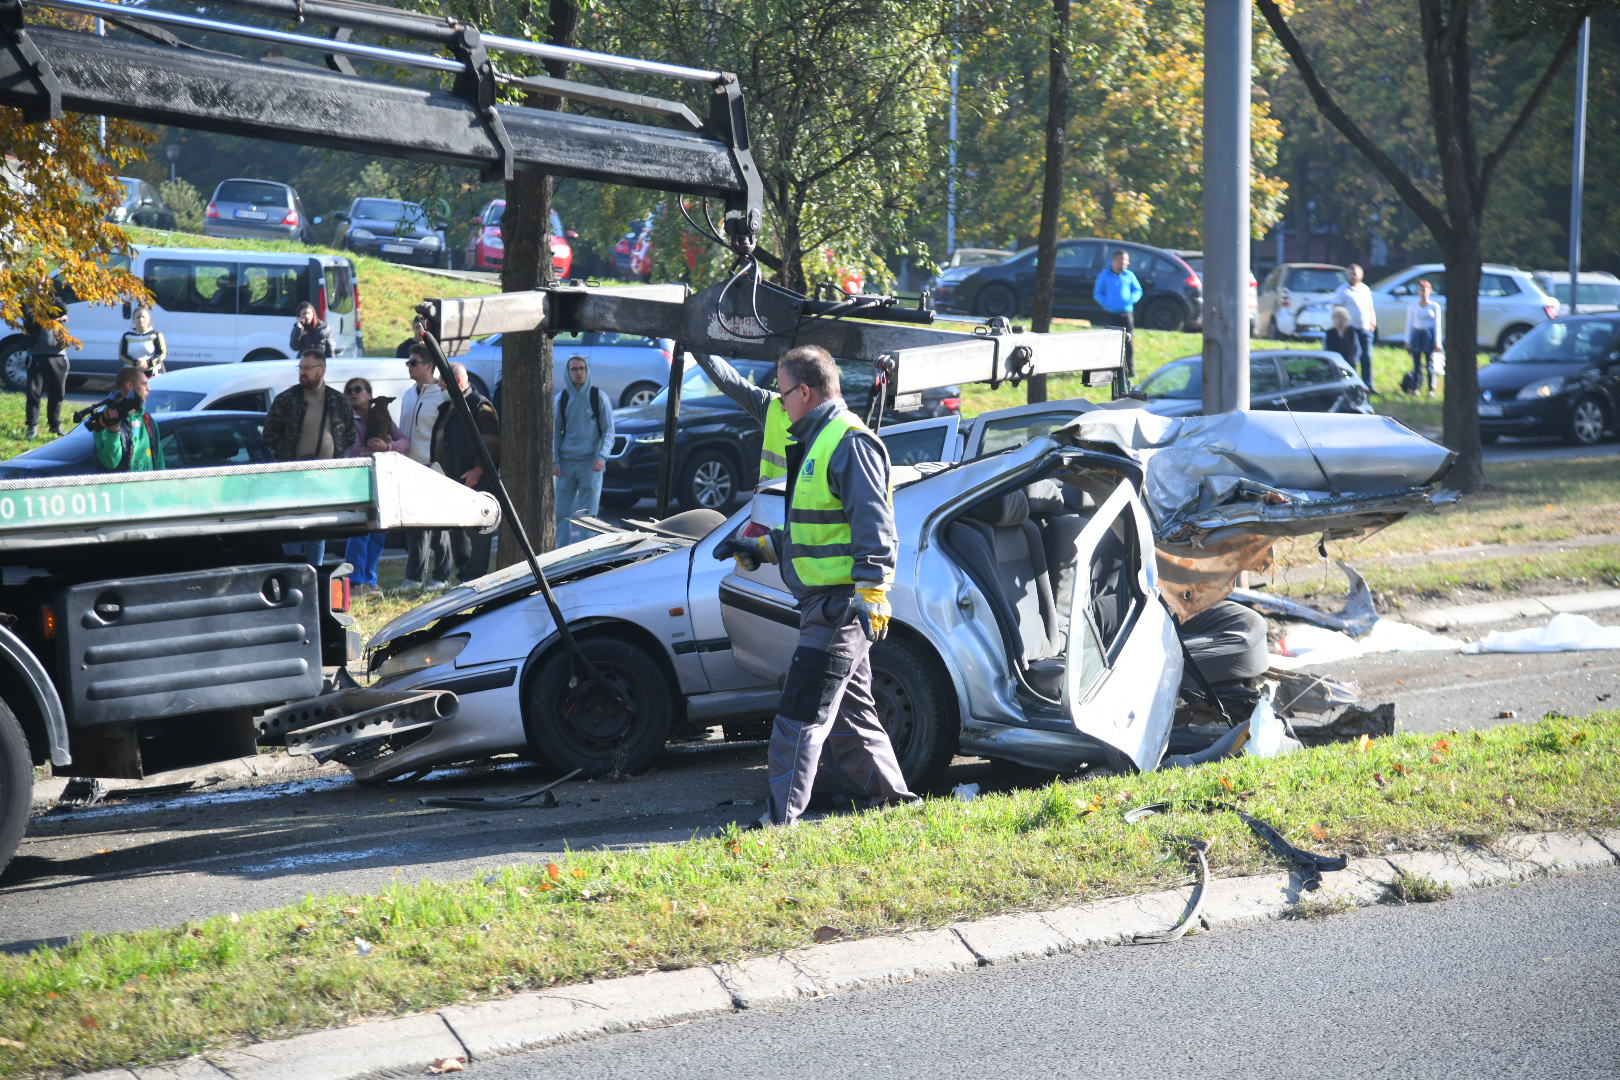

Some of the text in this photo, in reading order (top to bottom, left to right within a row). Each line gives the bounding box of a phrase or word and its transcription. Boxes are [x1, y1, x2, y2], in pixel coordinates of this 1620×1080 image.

[0, 492, 111, 519] 0 110 011
